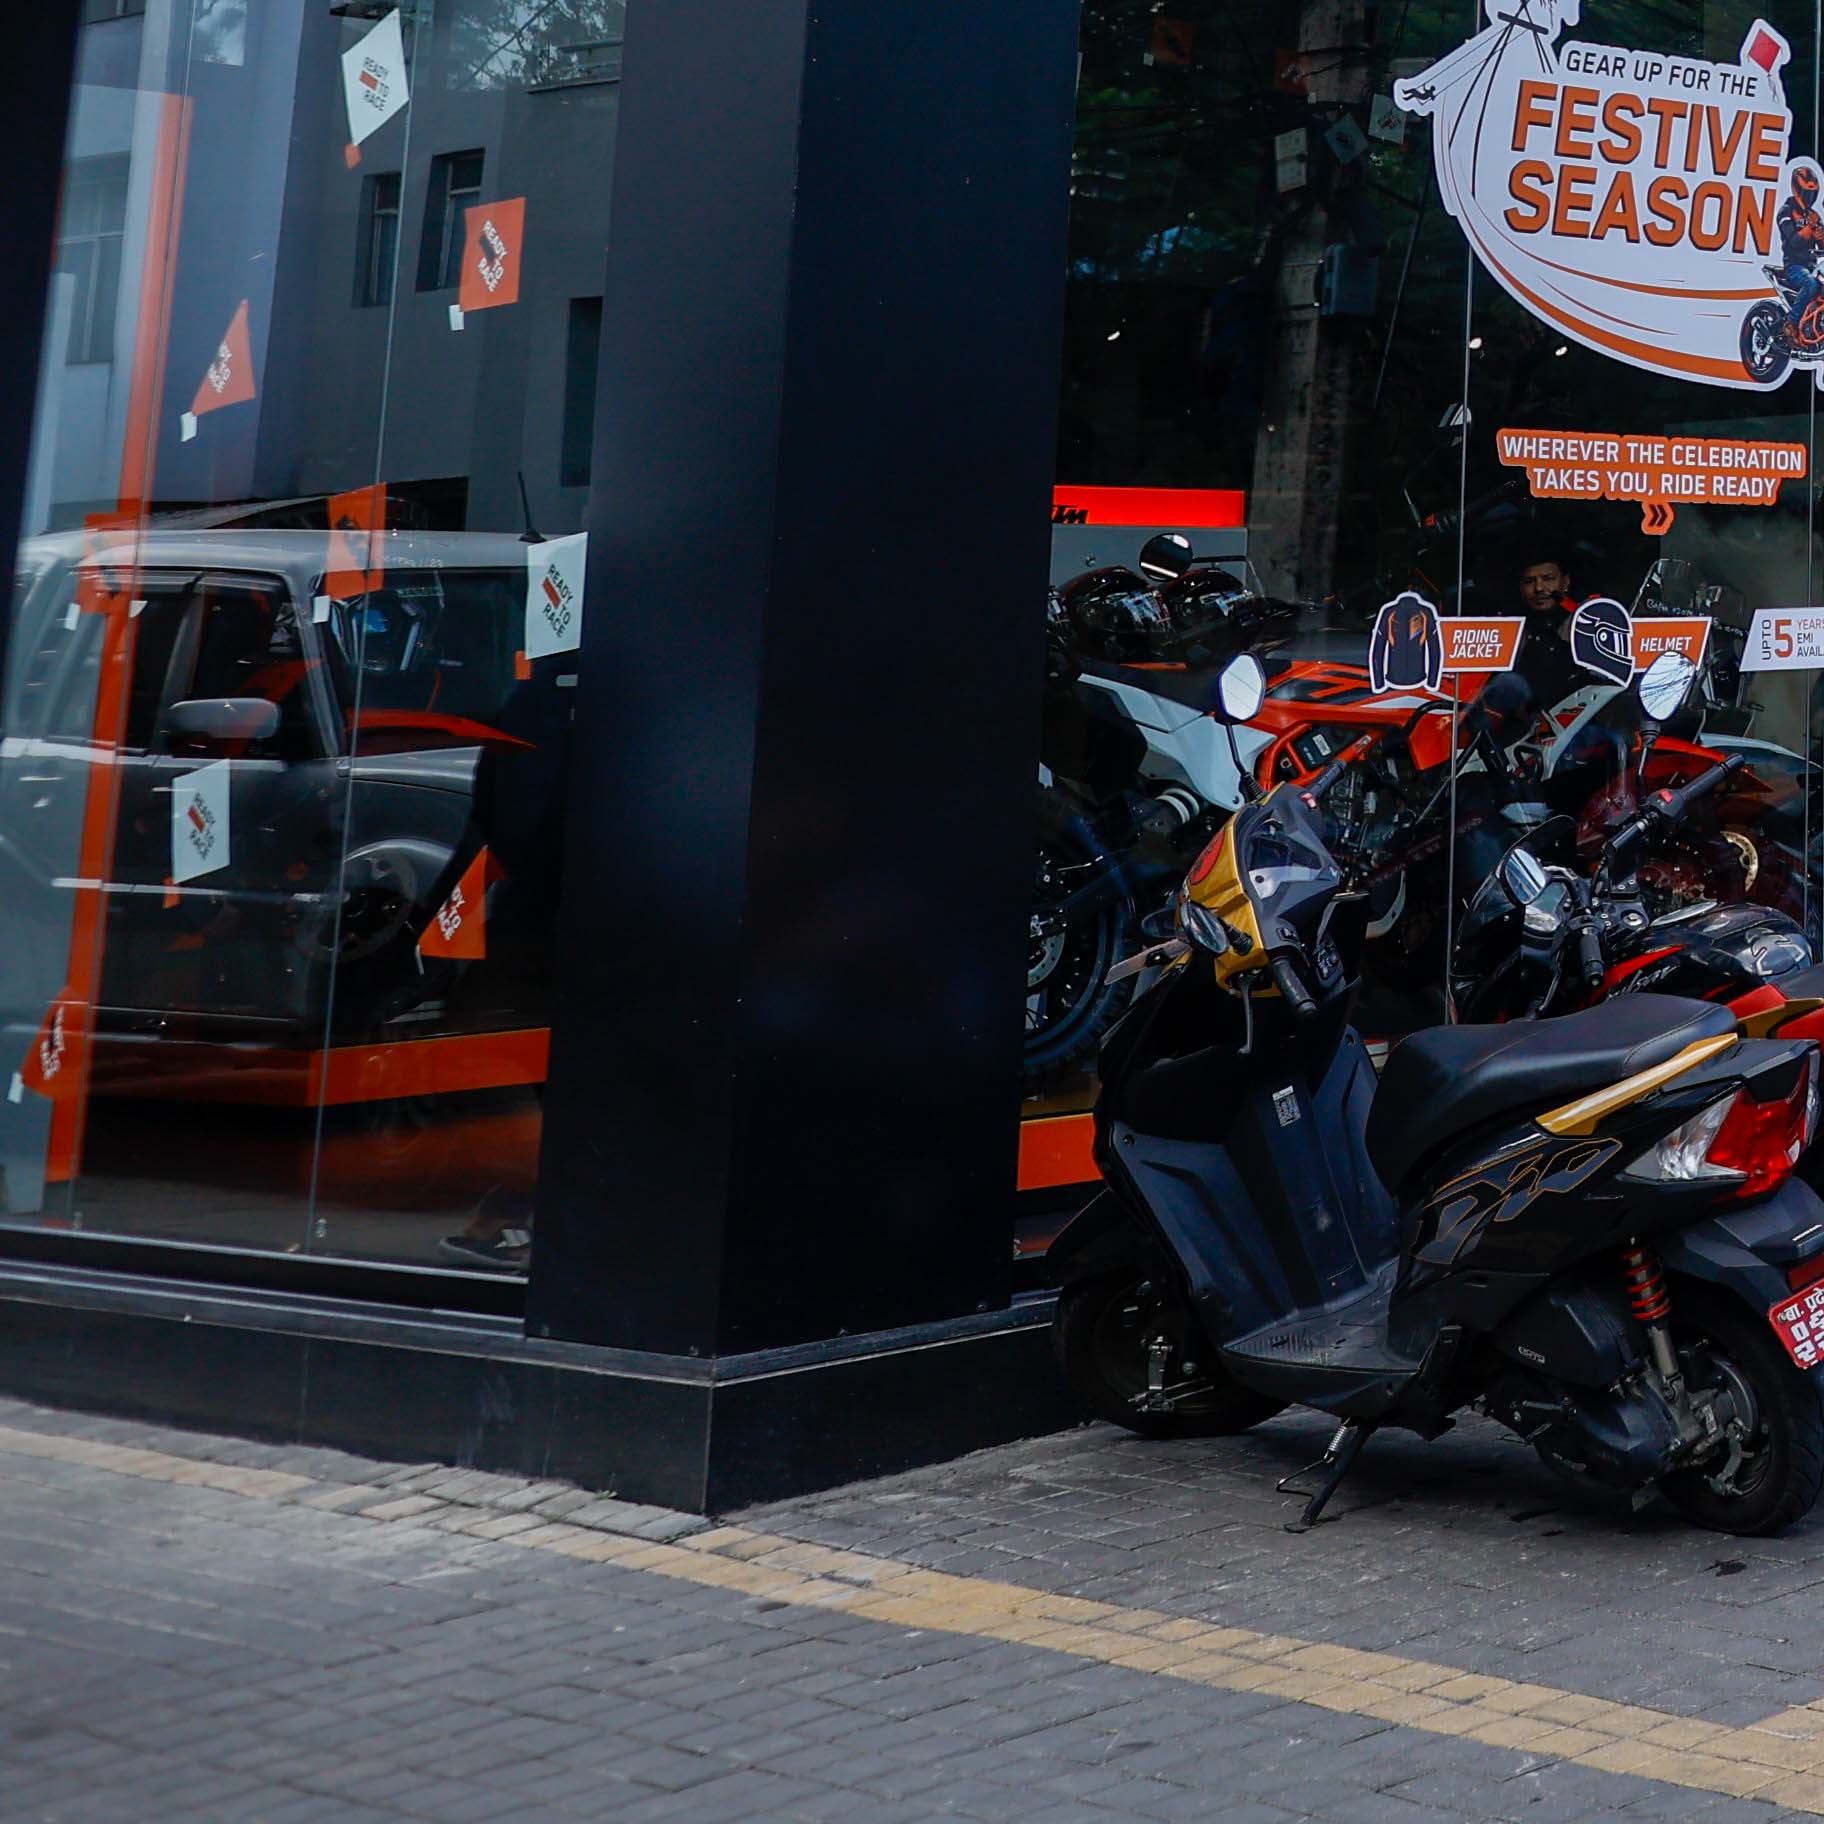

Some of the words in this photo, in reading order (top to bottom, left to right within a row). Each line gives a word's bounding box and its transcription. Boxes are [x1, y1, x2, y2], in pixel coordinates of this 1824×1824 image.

[363, 57, 388, 81] READY
[1566, 49, 1625, 79] GEAR
[1634, 61, 1663, 84] UP
[1669, 65, 1710, 91] FOR
[1719, 73, 1758, 98] THE
[361, 90, 386, 111] RACE
[1510, 79, 1785, 182] FESTIVE
[1504, 160, 1780, 256] SEASON
[483, 221, 508, 260] READY
[478, 258, 498, 292] RACE
[492, 259, 504, 280] TO
[1503, 435, 1619, 464] WHEREVER
[1626, 442, 1666, 466] THE
[1671, 443, 1802, 472] CELEBRATION
[1533, 467, 1600, 494] TAKES
[1606, 471, 1655, 497] YOU,
[1660, 472, 1706, 496] RIDE
[1711, 473, 1779, 499] READY
[1053, 504, 1088, 524] TM
[548, 564, 573, 604] READY
[543, 603, 565, 638] RACE
[560, 605, 571, 626] TO
[1449, 642, 1504, 659] JACKET
[1452, 629, 1500, 645] RIDING
[1639, 635, 1693, 653] HELMET
[1774, 619, 1794, 658] 5
[1797, 633, 1814, 644] EMI
[194, 793, 216, 824] READY
[449, 906, 462, 929] TO
